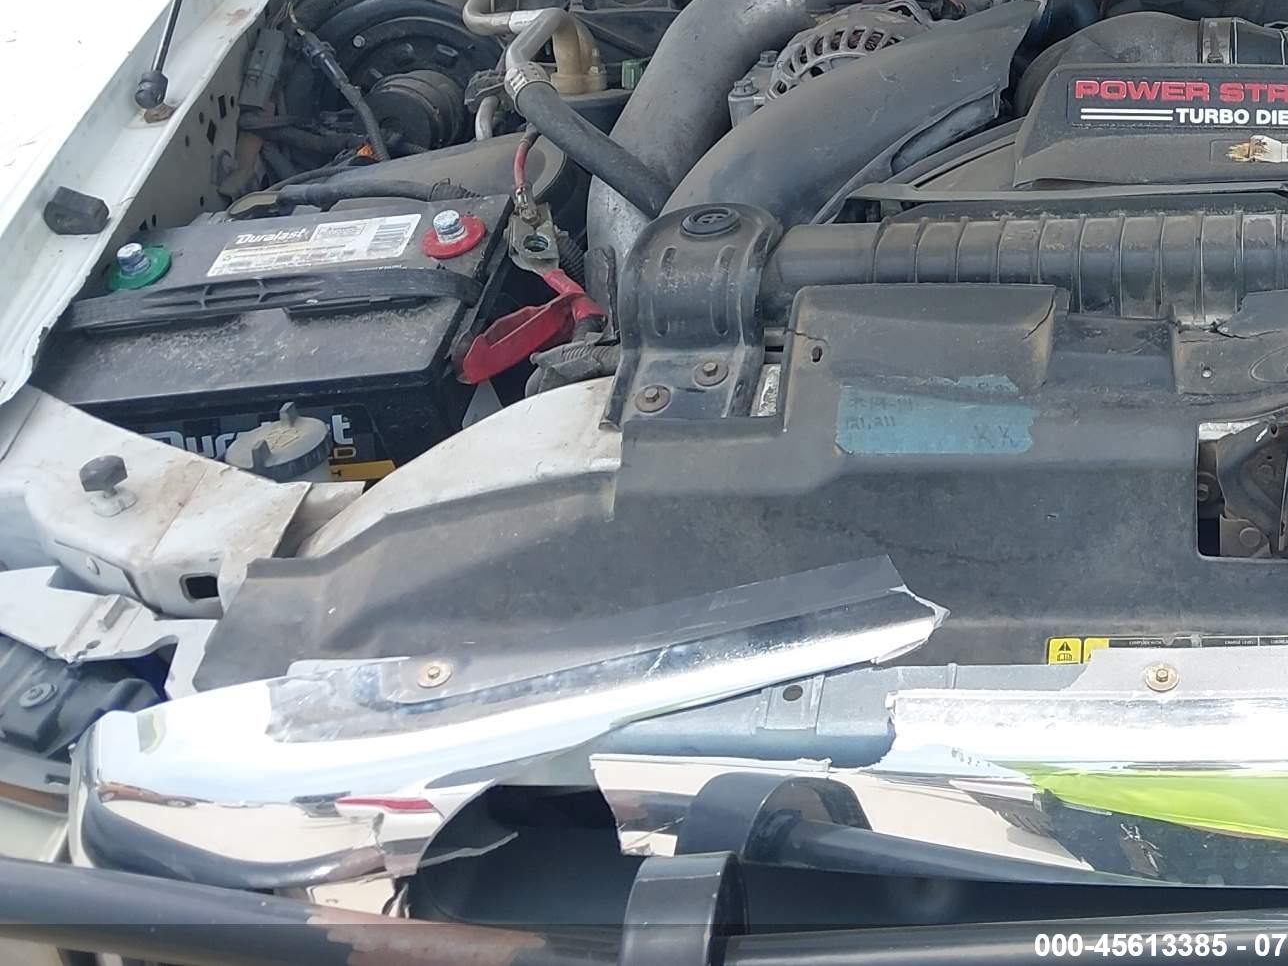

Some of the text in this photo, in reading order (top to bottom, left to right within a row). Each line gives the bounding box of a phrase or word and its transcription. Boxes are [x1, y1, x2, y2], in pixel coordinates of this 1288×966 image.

[1075, 80, 1210, 102] POWER
[1176, 108, 1251, 125] TURBO
[235, 227, 307, 245] Duralast
